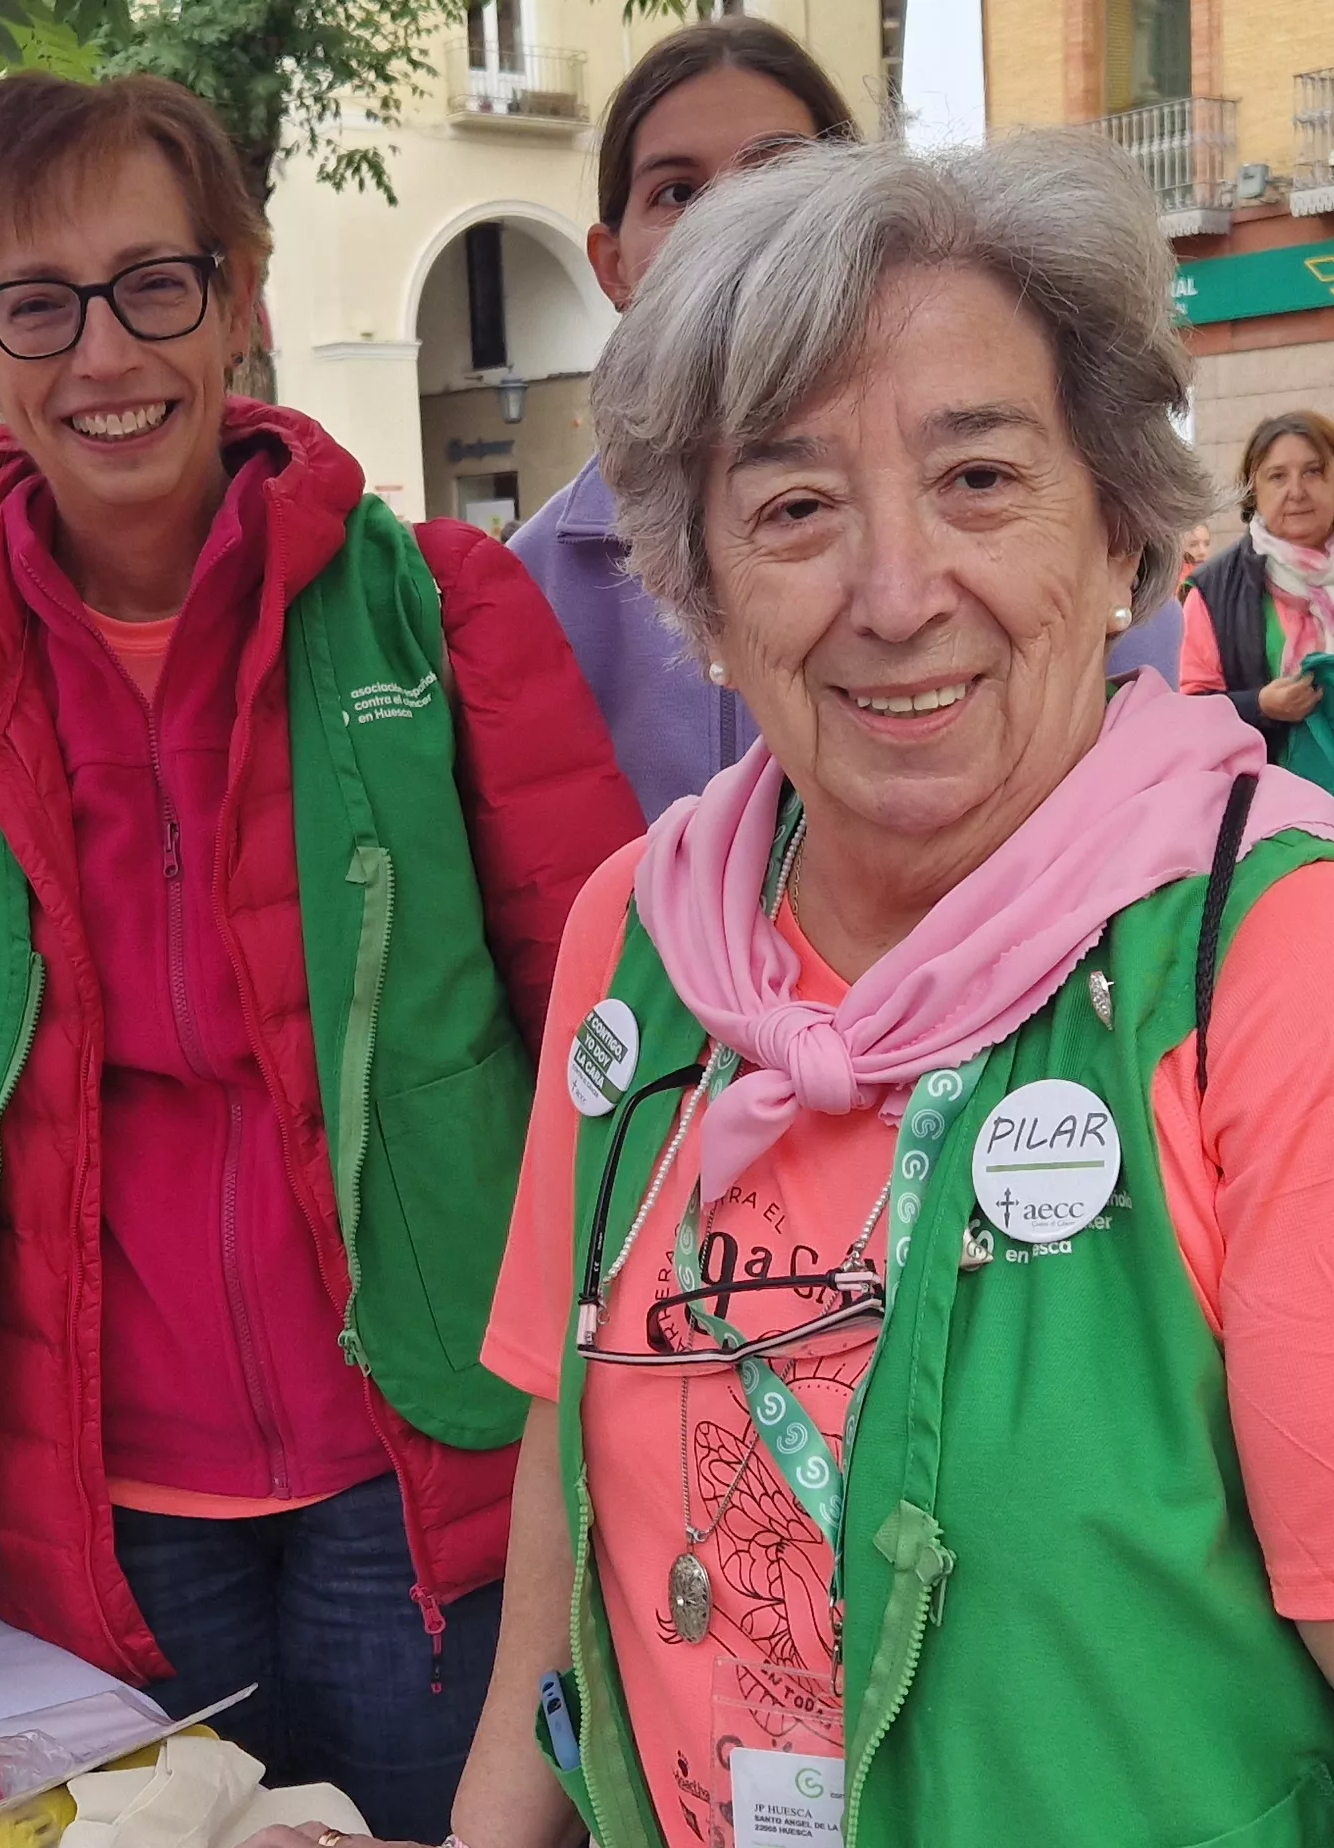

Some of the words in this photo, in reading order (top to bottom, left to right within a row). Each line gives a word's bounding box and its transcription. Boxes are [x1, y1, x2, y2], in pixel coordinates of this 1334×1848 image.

[354, 695, 392, 711] contra
[358, 712, 374, 724] en
[374, 707, 414, 720] Huesca
[584, 1033, 596, 1050] YO
[593, 1046, 611, 1067] DOY
[576, 1050, 587, 1068] LA
[585, 1060, 605, 1090] CARA
[986, 1112, 1109, 1155] PILAR
[762, 1202, 789, 1235] EL
[1023, 1202, 1085, 1221] aecc
[1005, 1248, 1029, 1264] en
[753, 1803, 766, 1813] JP
[768, 1803, 814, 1820] HUESCA
[754, 1814, 783, 1825] SANTO
[814, 1822, 826, 1830] DE
[827, 1823, 840, 1833] LA
[779, 1827, 814, 1839] HUESCA
